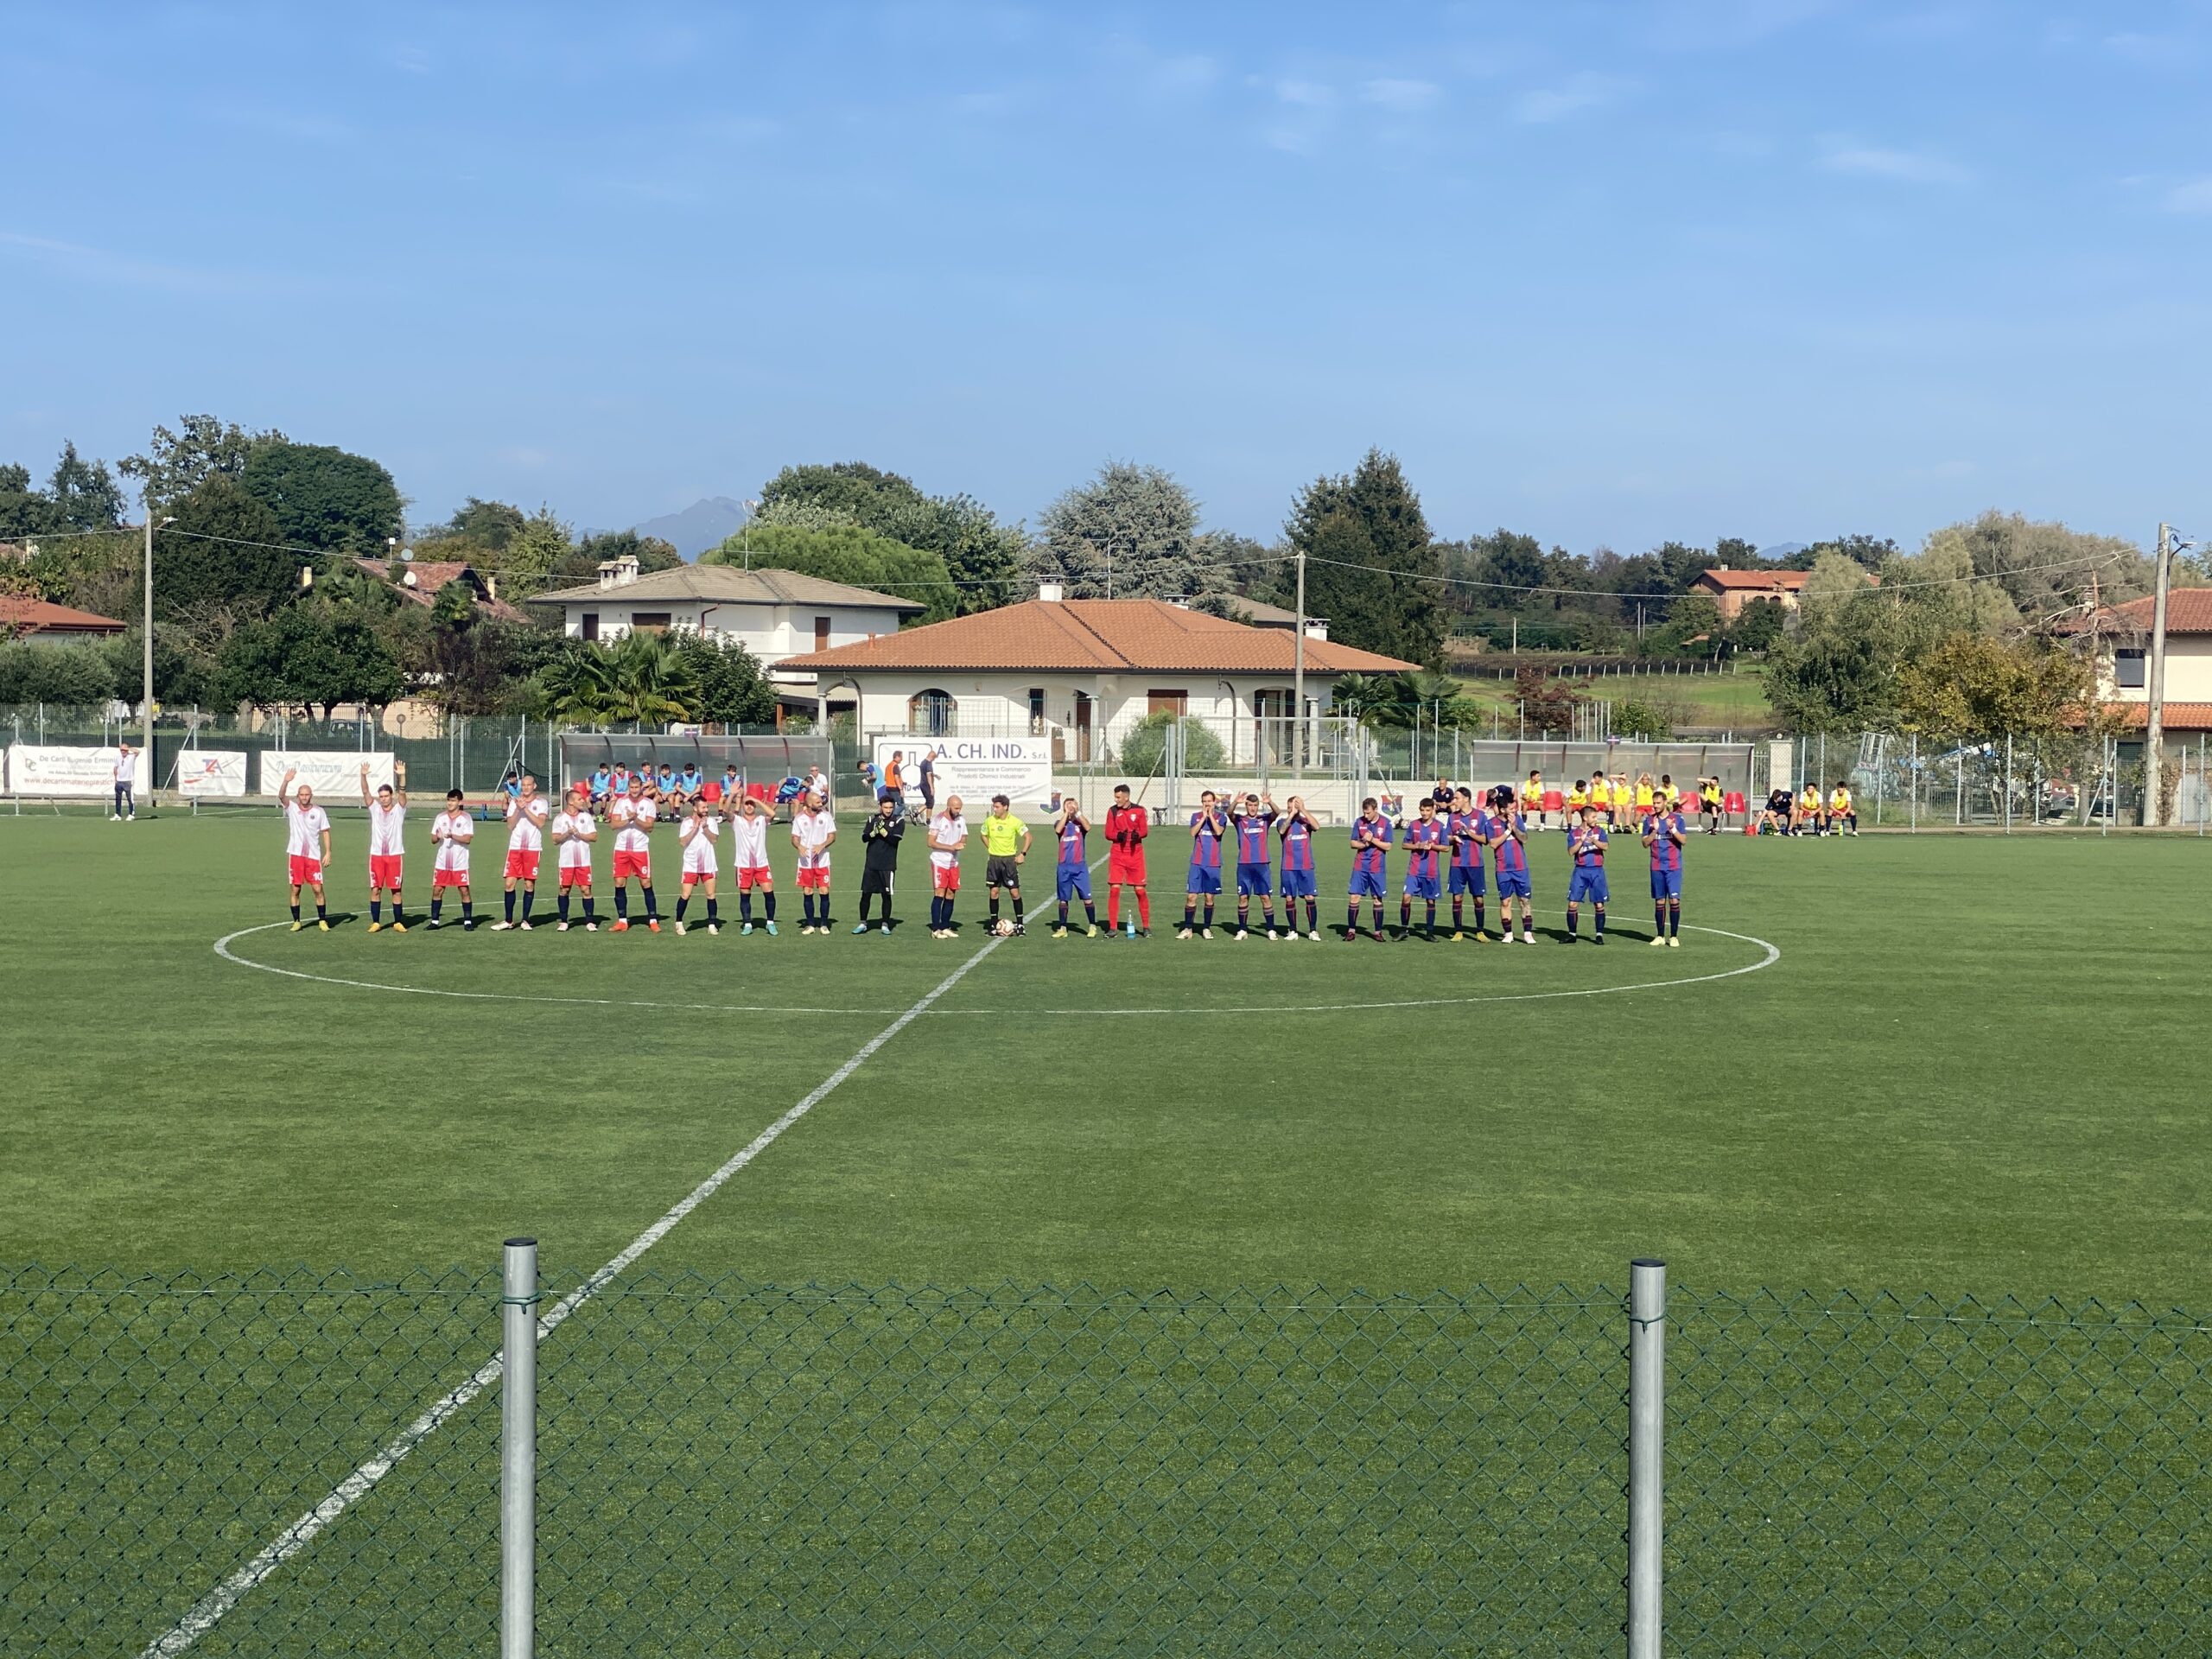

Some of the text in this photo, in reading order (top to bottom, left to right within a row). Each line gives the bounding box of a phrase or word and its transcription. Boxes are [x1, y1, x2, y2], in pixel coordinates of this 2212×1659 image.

[937, 743, 952, 759] A.
[957, 743, 987, 759] CH.
[993, 743, 1027, 759] IND.
[532, 867, 538, 875] 5
[641, 866, 647, 874] 6
[313, 872, 322, 881] 10
[461, 873, 467, 882] 2
[823, 874, 830, 884] 9
